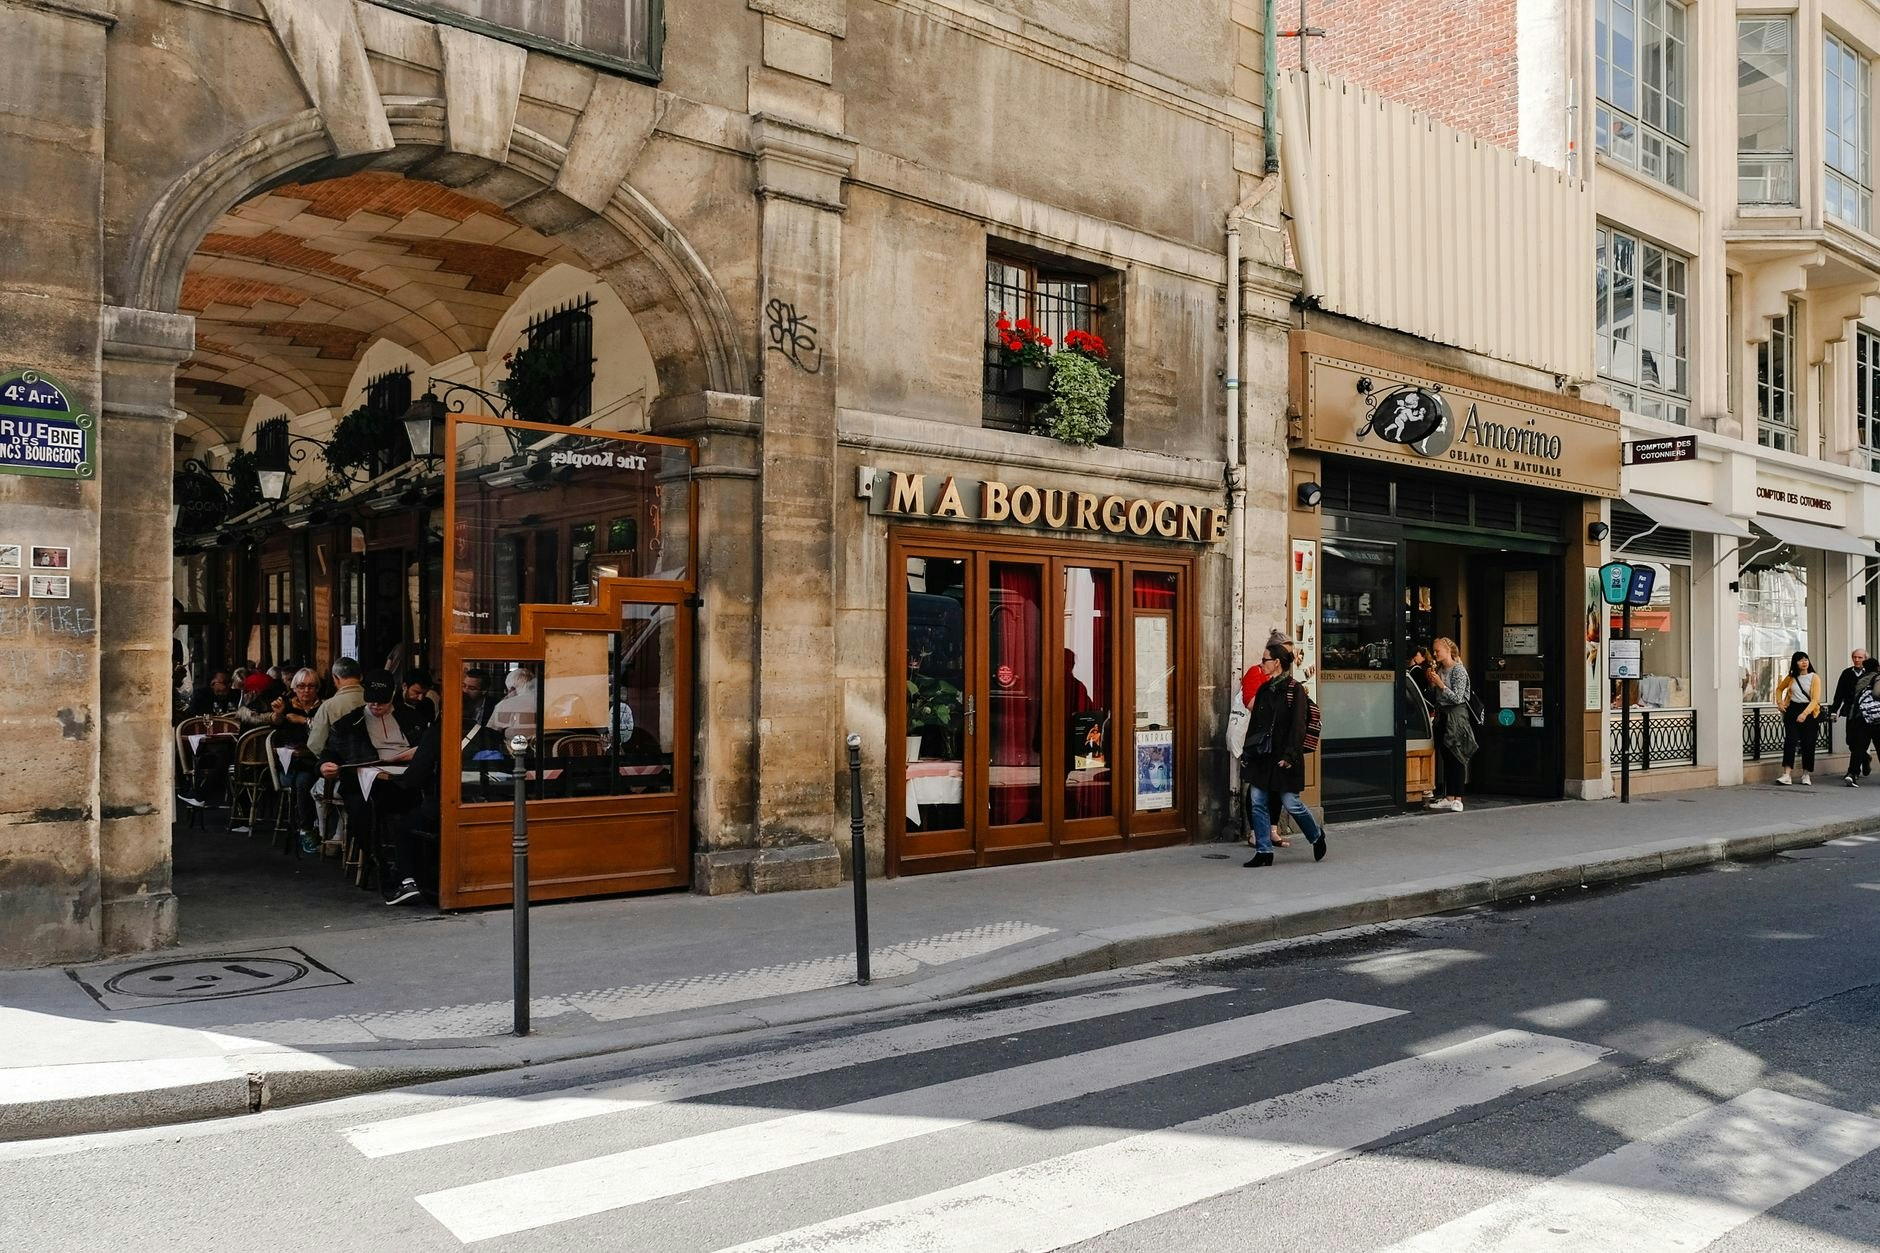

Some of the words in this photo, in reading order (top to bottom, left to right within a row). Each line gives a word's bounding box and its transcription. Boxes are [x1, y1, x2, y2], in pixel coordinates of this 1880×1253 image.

[1, 420, 48, 439] RUE
[51, 430, 79, 446] BNE
[1458, 403, 1561, 460] Amorino
[12, 437, 39, 446] DES
[1636, 442, 1673, 452] COMPTOIR
[1677, 440, 1691, 448] DES
[25, 446, 81, 464] BOURGEOIS
[1640, 449, 1686, 460] COTONNIERS
[1450, 450, 1489, 465] GELATO
[1496, 458, 1508, 469] AL
[1514, 460, 1562, 478] NATURALE
[1756, 487, 1785, 502] COMPTOIR
[1787, 493, 1798, 504] DES
[1800, 495, 1832, 511] COTONNIERS
[977, 480, 1228, 544] BOURGOGNE
